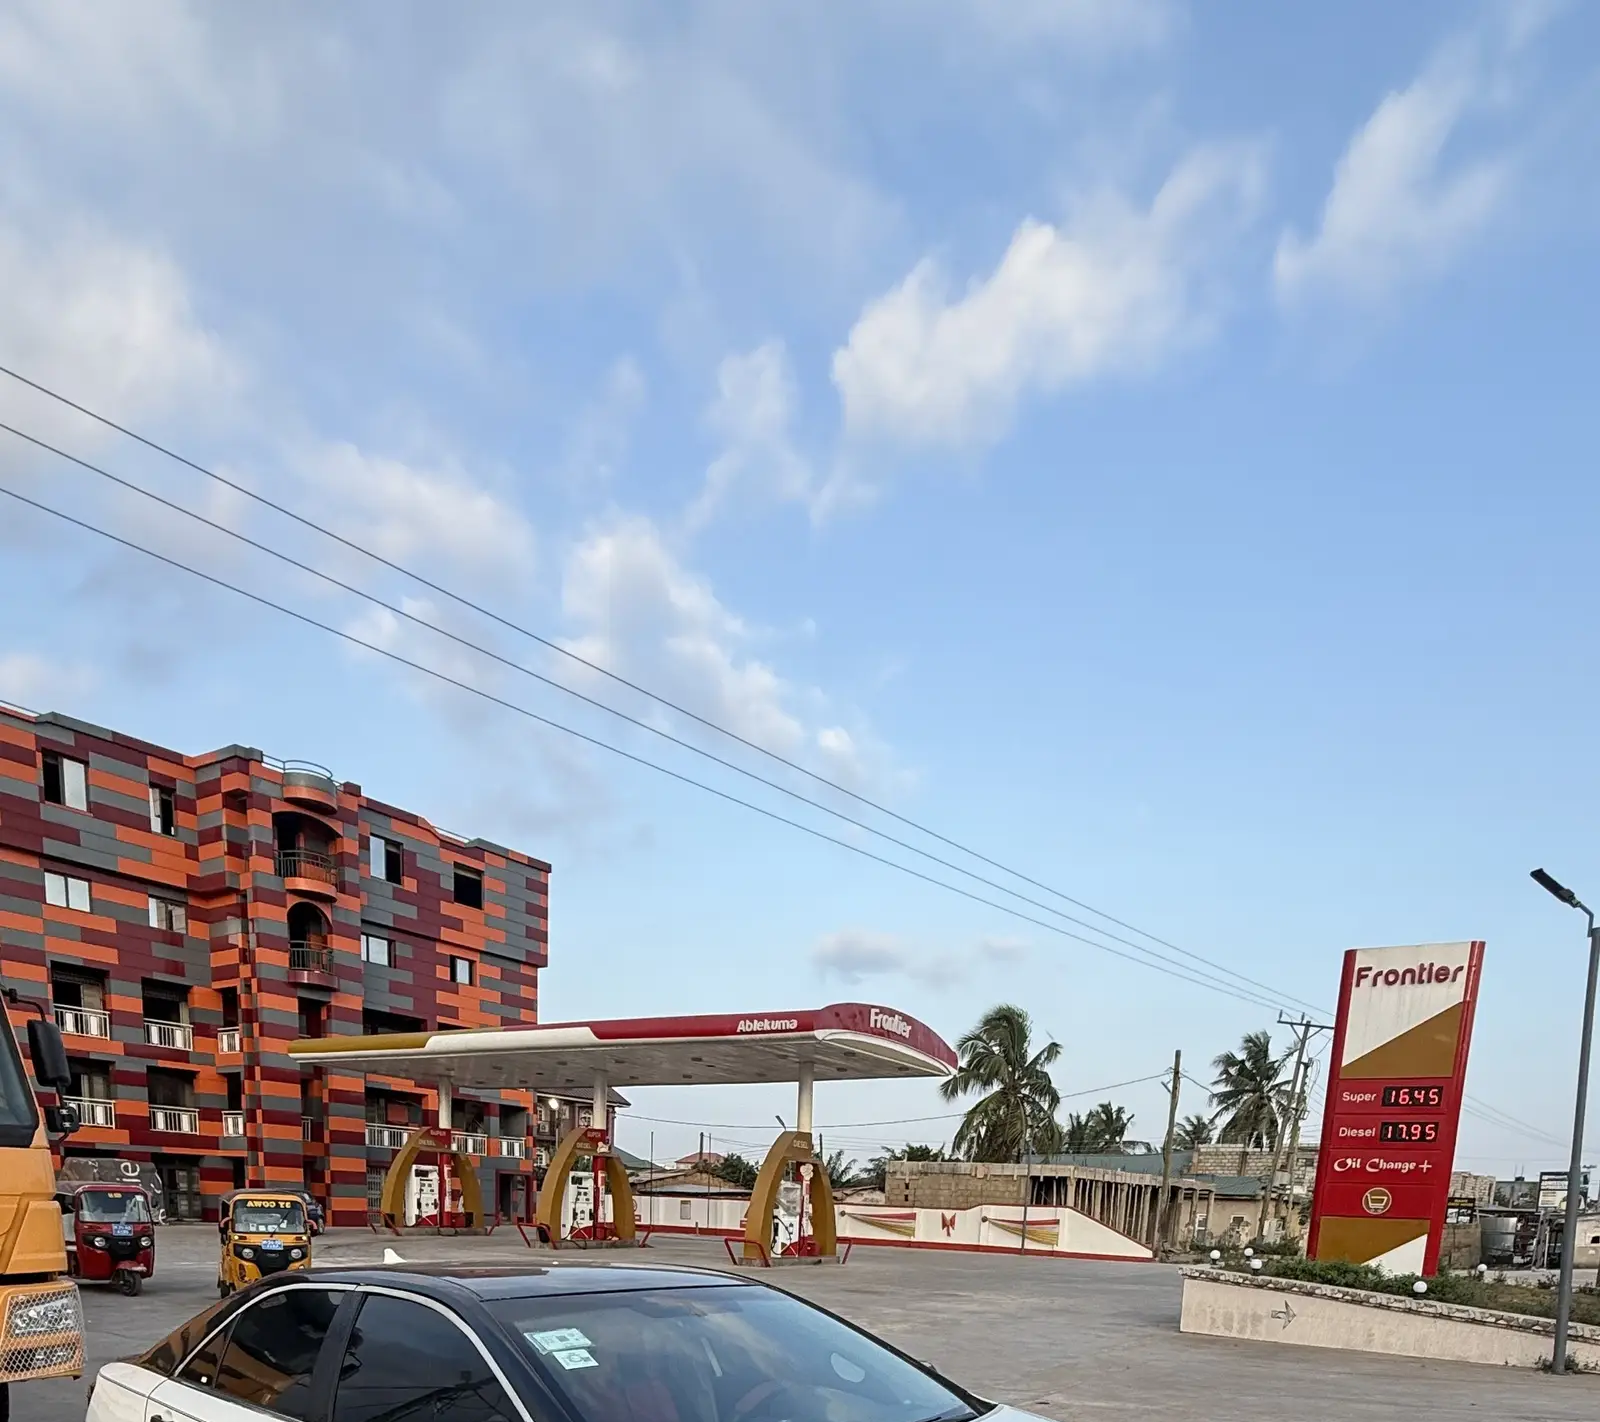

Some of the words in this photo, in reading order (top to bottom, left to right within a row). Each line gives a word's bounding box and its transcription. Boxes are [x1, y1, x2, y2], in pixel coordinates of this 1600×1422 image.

[1354, 962, 1464, 988] Frontier
[737, 1018, 798, 1033] Ablekuma
[869, 1008, 912, 1039] Frontier
[1342, 1091, 1377, 1104] Super
[1390, 1088, 1439, 1105] 16.45
[1338, 1127, 1376, 1137] Diesel
[1387, 1124, 1436, 1140] 17.95
[1333, 1158, 1361, 1172] Oil
[1365, 1158, 1416, 1173] Change
